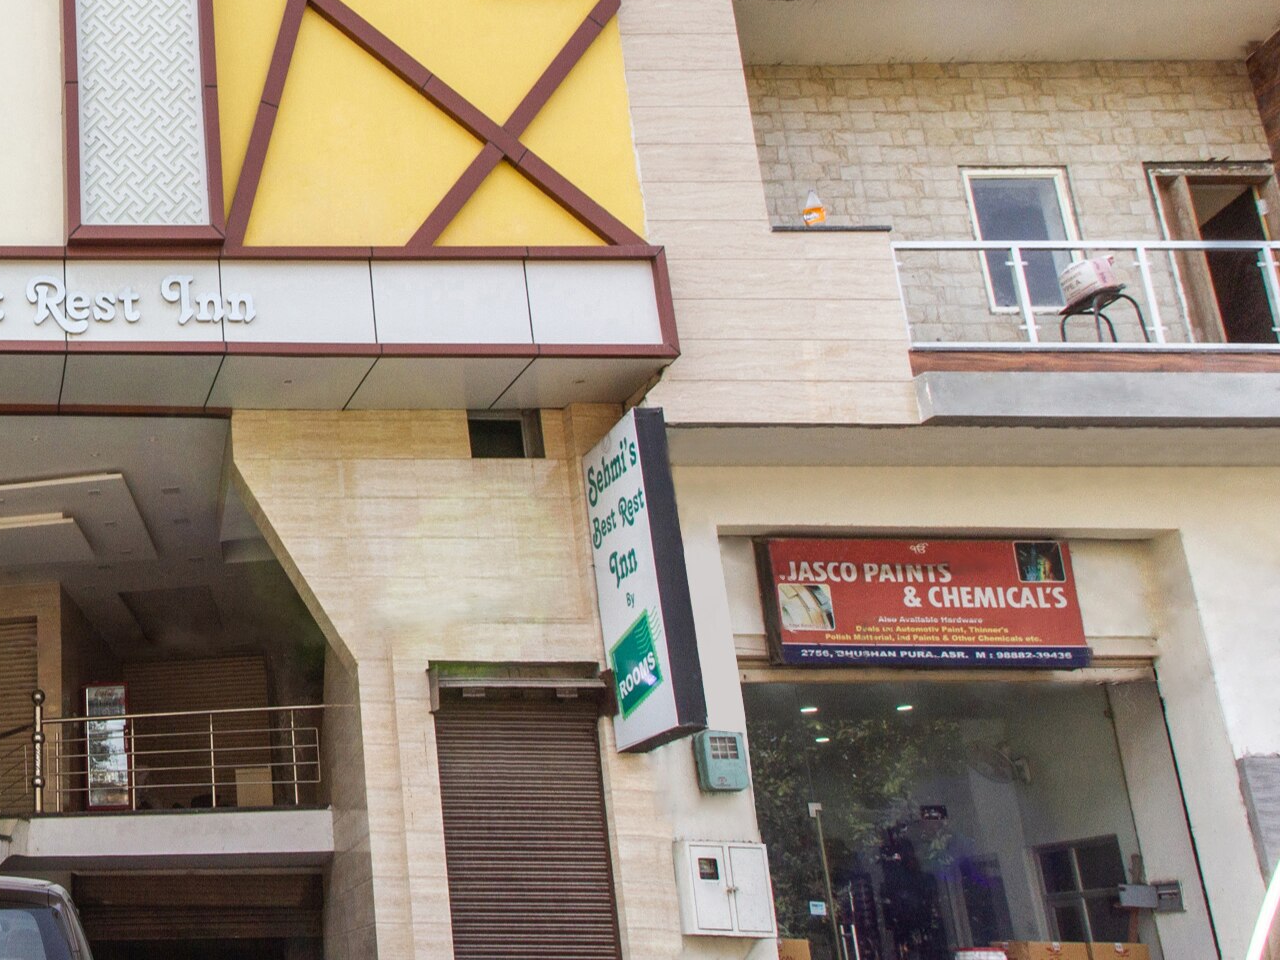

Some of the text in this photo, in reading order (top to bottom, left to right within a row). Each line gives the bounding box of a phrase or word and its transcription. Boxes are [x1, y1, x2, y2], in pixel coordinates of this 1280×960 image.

[25, 275, 141, 334] Rest
[160, 274, 257, 326] Inn
[587, 436, 638, 508] Sehmi's
[593, 487, 645, 550] Best Rest
[609, 546, 638, 589] Inn
[787, 561, 952, 584] JASCO PAINTS
[626, 592, 636, 609] By
[903, 586, 1068, 609] & CHEMICAL'S
[619, 652, 656, 700] ROOMS
